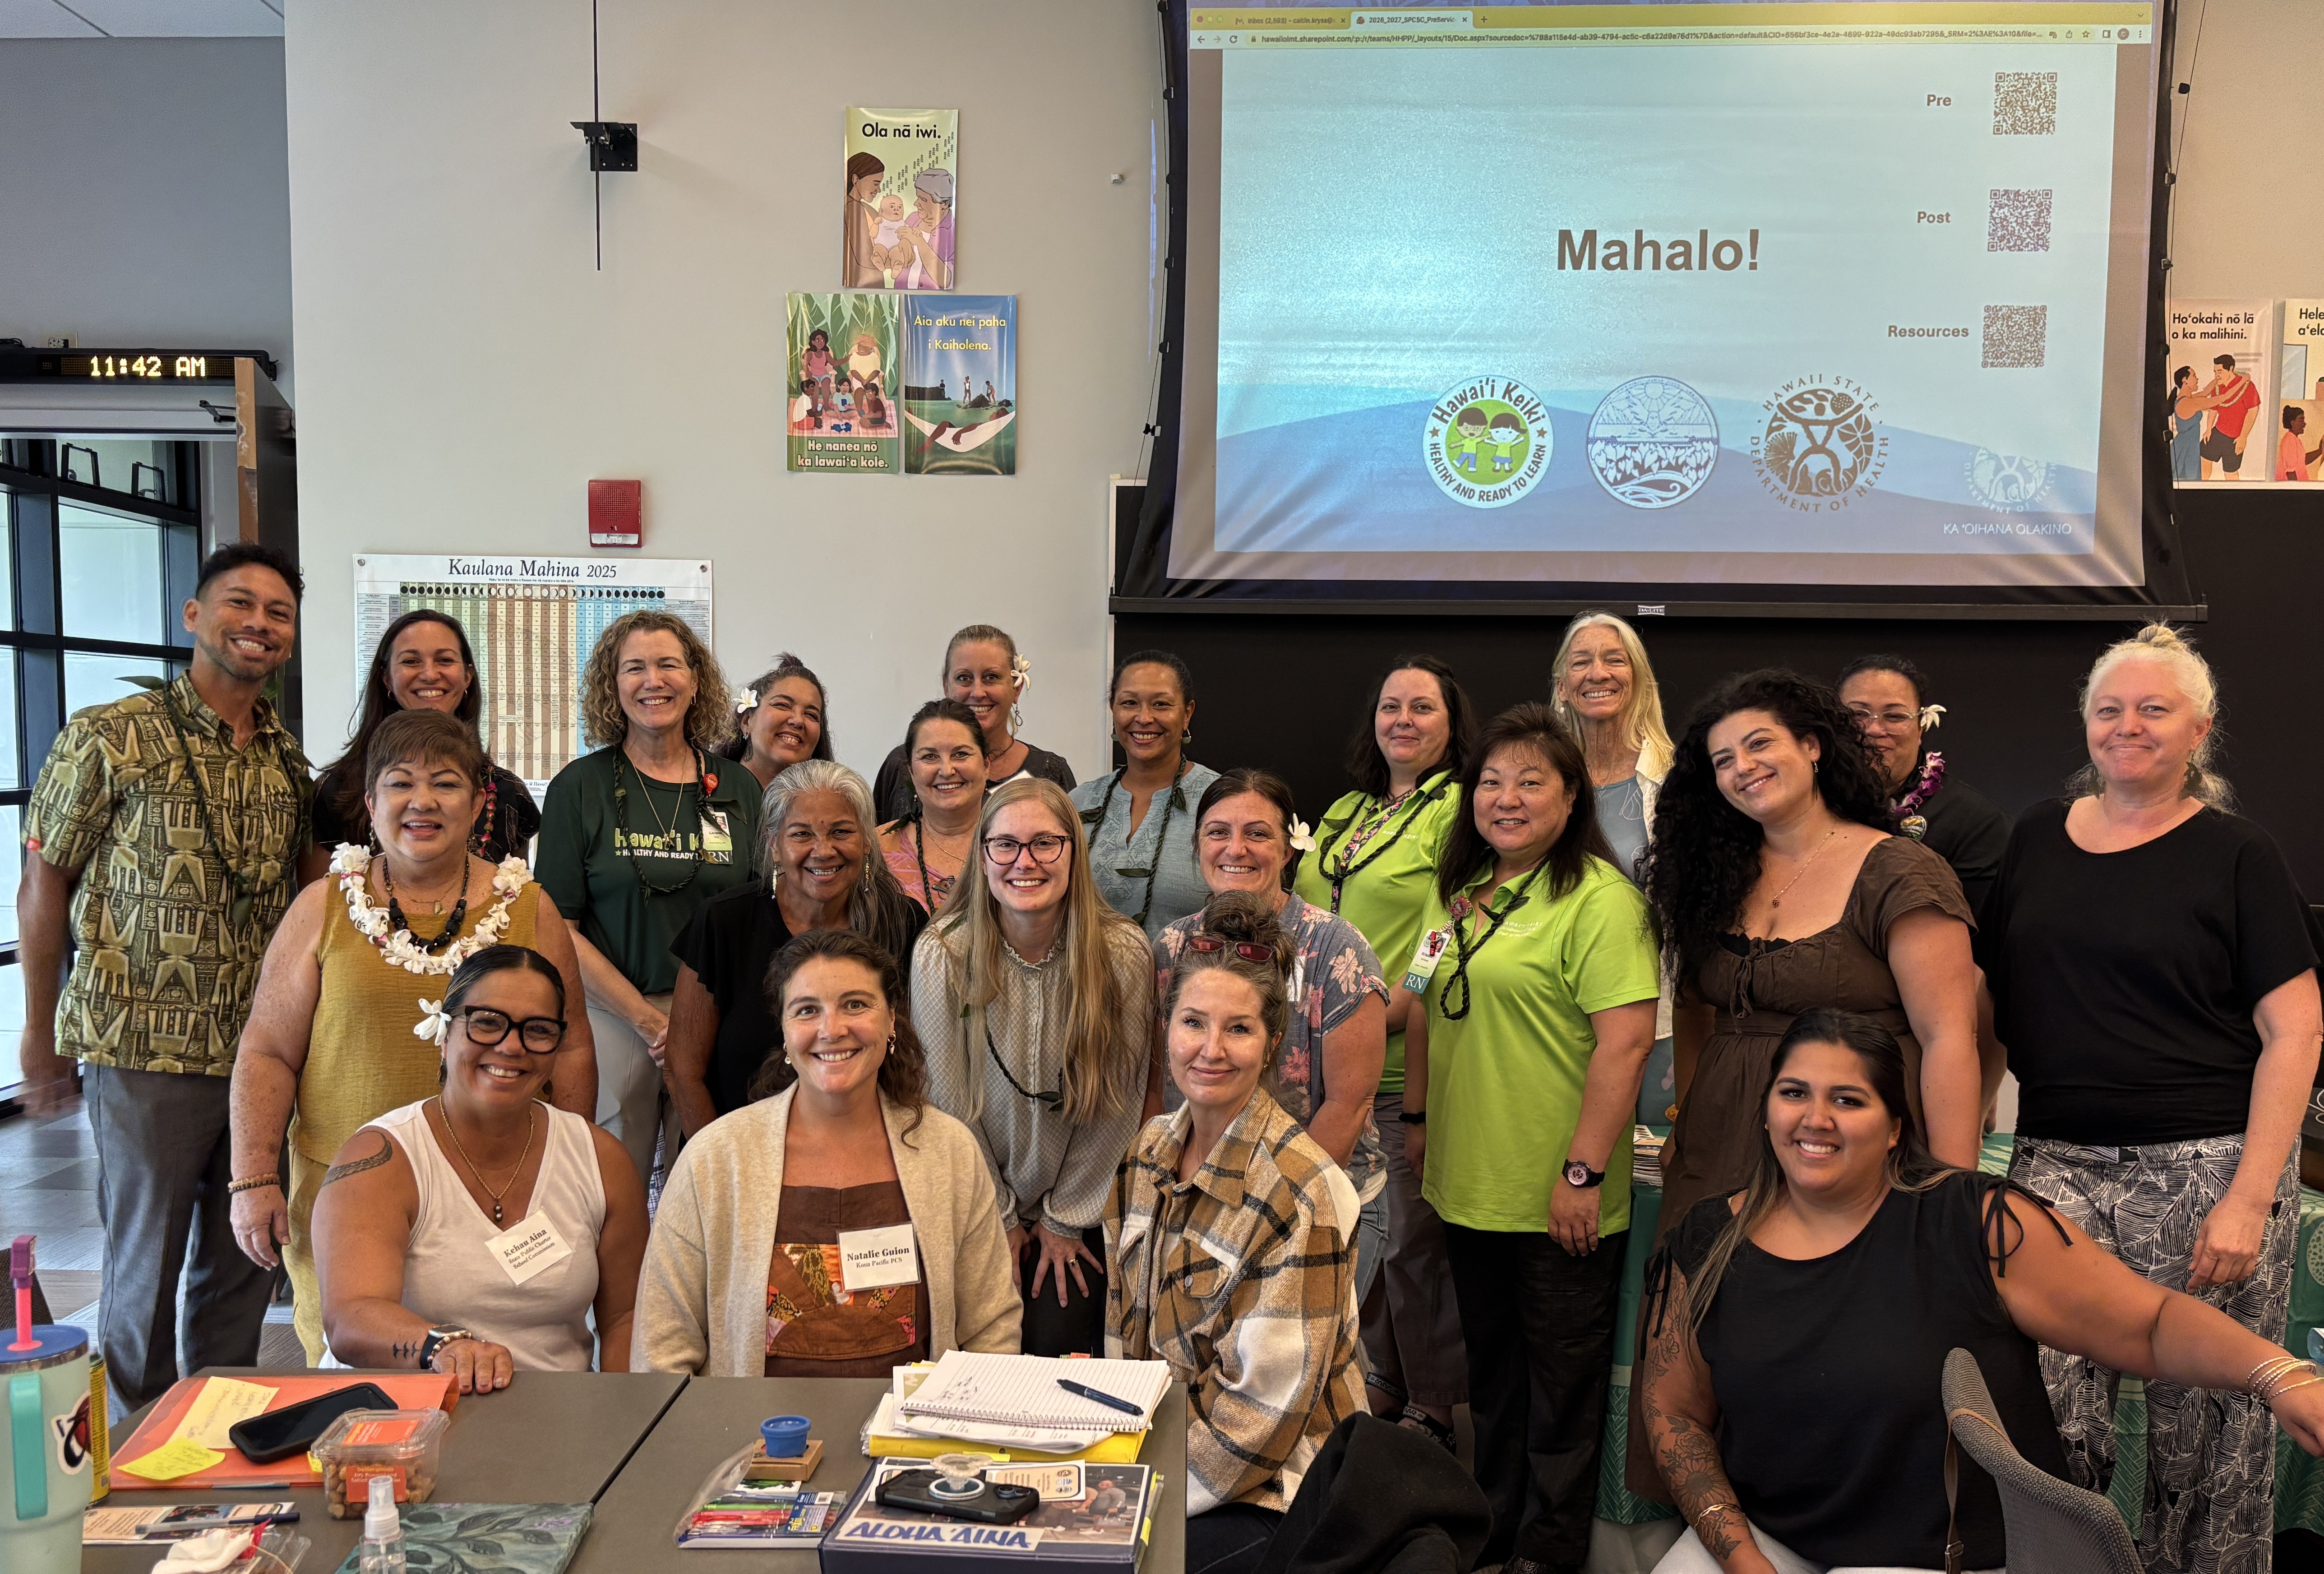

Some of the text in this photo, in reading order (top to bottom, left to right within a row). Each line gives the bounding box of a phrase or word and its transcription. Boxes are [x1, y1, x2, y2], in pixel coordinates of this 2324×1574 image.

[1927, 94, 1951, 106] Pre
[862, 122, 941, 138] Ola nā iwi.
[1917, 211, 1951, 223] Post
[1557, 229, 1759, 271] Mahalo!
[914, 315, 1006, 330] Aia aku nei paha
[2227, 314, 2240, 324] nō
[2244, 314, 2254, 324] lā
[1888, 325, 1969, 337] Resources
[2183, 328, 2195, 339] ka
[2200, 328, 2247, 340] malihini.
[928, 339, 991, 351] i Kaiholena.
[91, 356, 205, 377] 11:42 AM
[1763, 374, 1879, 411] HAWAII STATE
[1432, 378, 1545, 424] Hawai'i Keiki
[808, 440, 878, 452] He nanea nō
[798, 455, 812, 467] ka
[860, 456, 888, 468] kole.
[1430, 443, 1546, 502] HEALTHY AND READY TO LEARN
[1751, 436, 1889, 512] DEPARTMENT OF HEALTH
[1944, 523, 1959, 534] KA
[2016, 523, 2071, 535] OLAKINO
[448, 559, 617, 578] Kaulana Mahina 2025
[1405, 974, 1426, 989] RN
[504, 1229, 547, 1257] Kehau Aina
[847, 1246, 910, 1261] Natalie Guion
[845, 1522, 946, 1542] ALOHA
